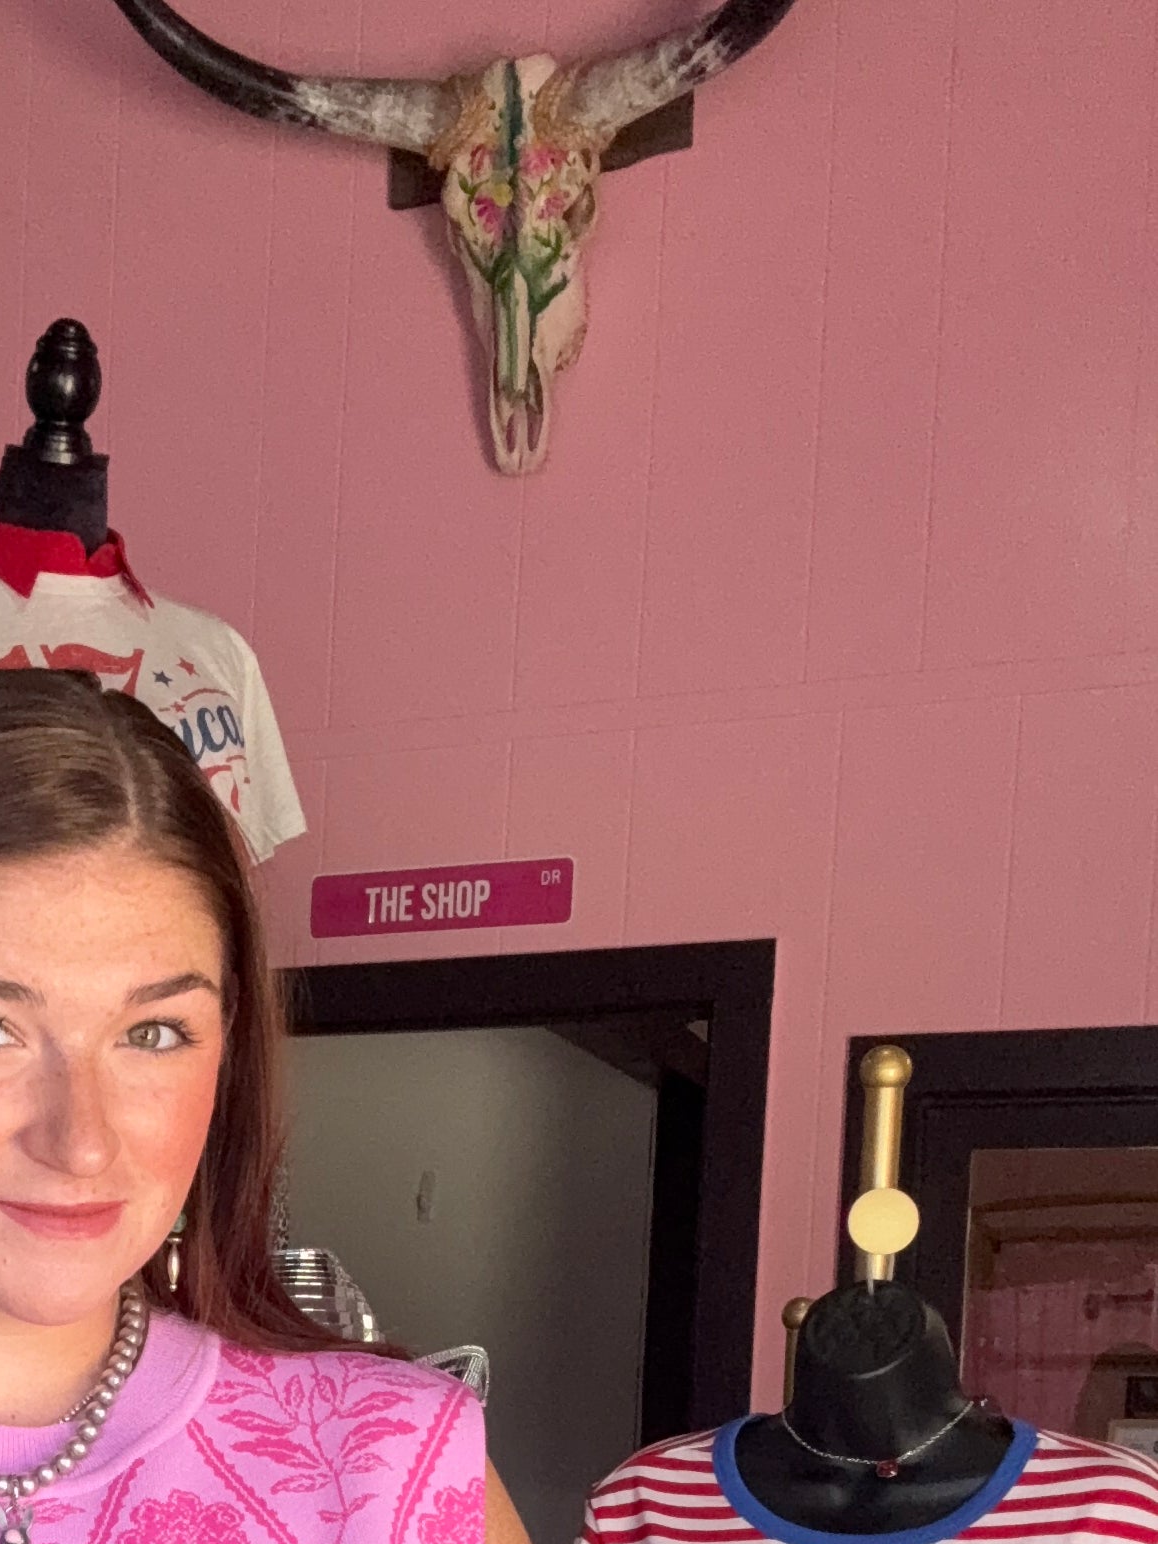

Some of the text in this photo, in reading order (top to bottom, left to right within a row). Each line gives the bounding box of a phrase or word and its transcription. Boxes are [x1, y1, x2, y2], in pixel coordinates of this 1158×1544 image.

[365, 869, 562, 924] THE SHOP DR
